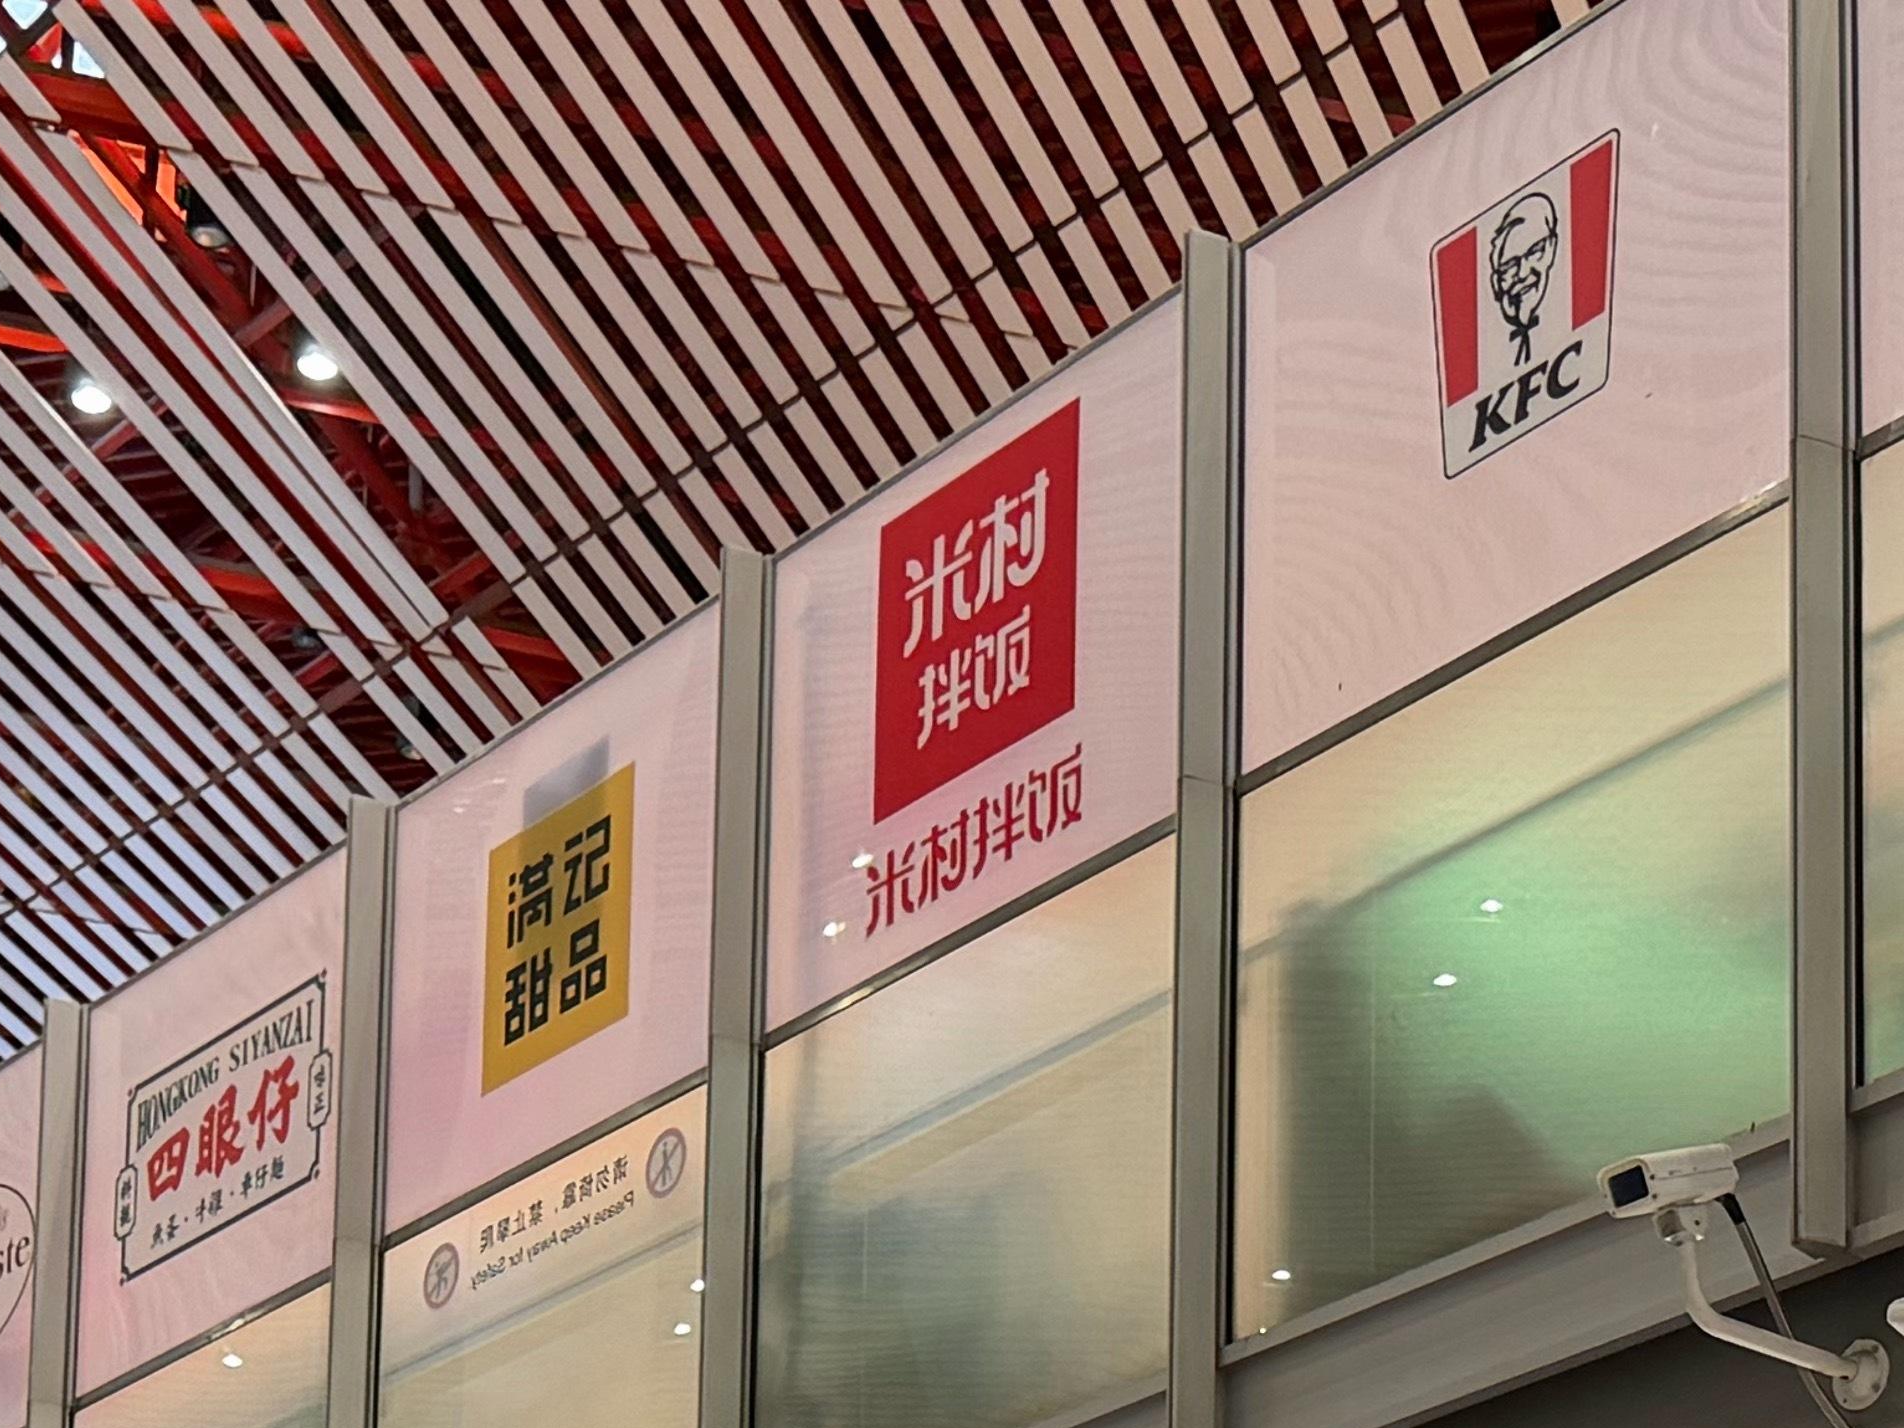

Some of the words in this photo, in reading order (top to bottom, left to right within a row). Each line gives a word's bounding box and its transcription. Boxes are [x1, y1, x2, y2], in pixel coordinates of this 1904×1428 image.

[1469, 340, 1582, 453] KFC
[903, 468, 1049, 659] 米村
[917, 605, 1031, 750] 拌饭
[507, 814, 611, 949] 满记
[866, 743, 1083, 938] 米村拌饭
[504, 918, 608, 1047] 甜品
[136, 1058, 220, 1153] HONGKONG
[229, 999, 314, 1072] SIYANZAI
[148, 1055, 300, 1201] 四眼仔
